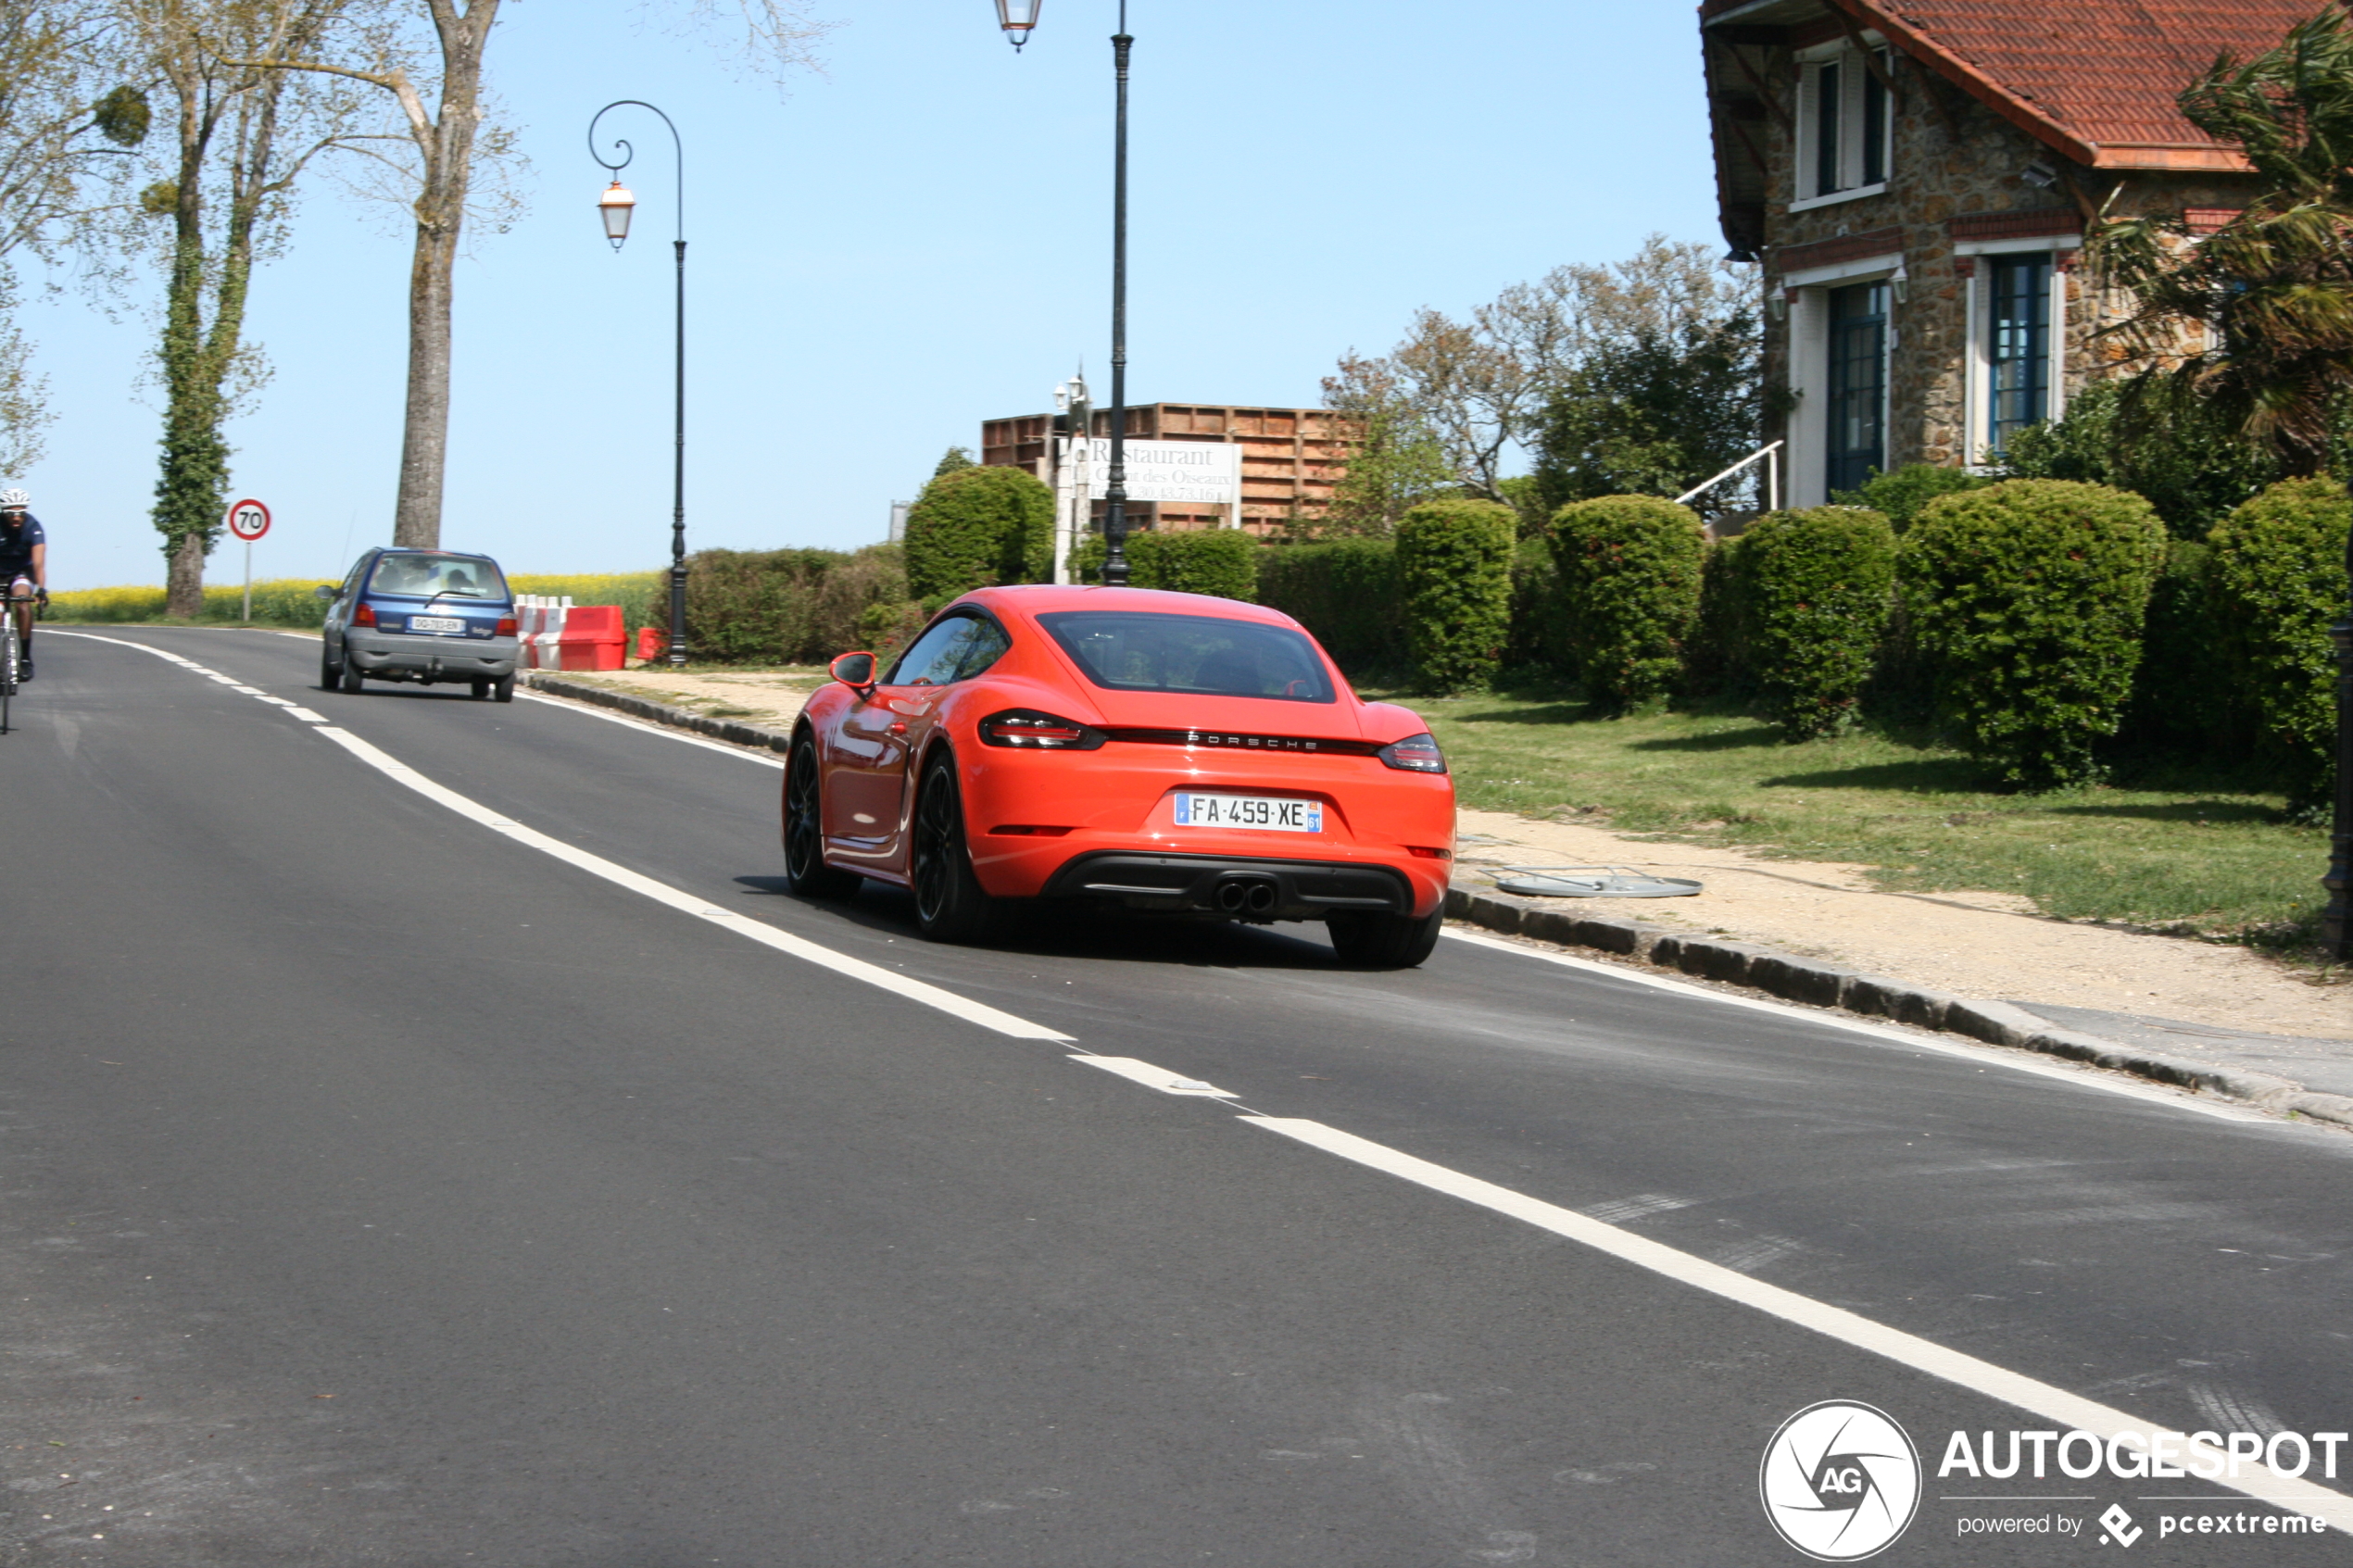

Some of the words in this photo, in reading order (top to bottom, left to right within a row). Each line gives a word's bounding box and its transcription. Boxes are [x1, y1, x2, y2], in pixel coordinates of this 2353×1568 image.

[1091, 440, 1214, 466] Rstaurant
[1096, 466, 1140, 483] Cnt
[1143, 469, 1168, 483] des
[1172, 470, 1231, 485] Oiseaux
[238, 511, 262, 530] 70
[1188, 734, 1316, 749] PORSCHE
[1192, 797, 1304, 826] FA-459-XE
[1308, 816, 1319, 829] 61
